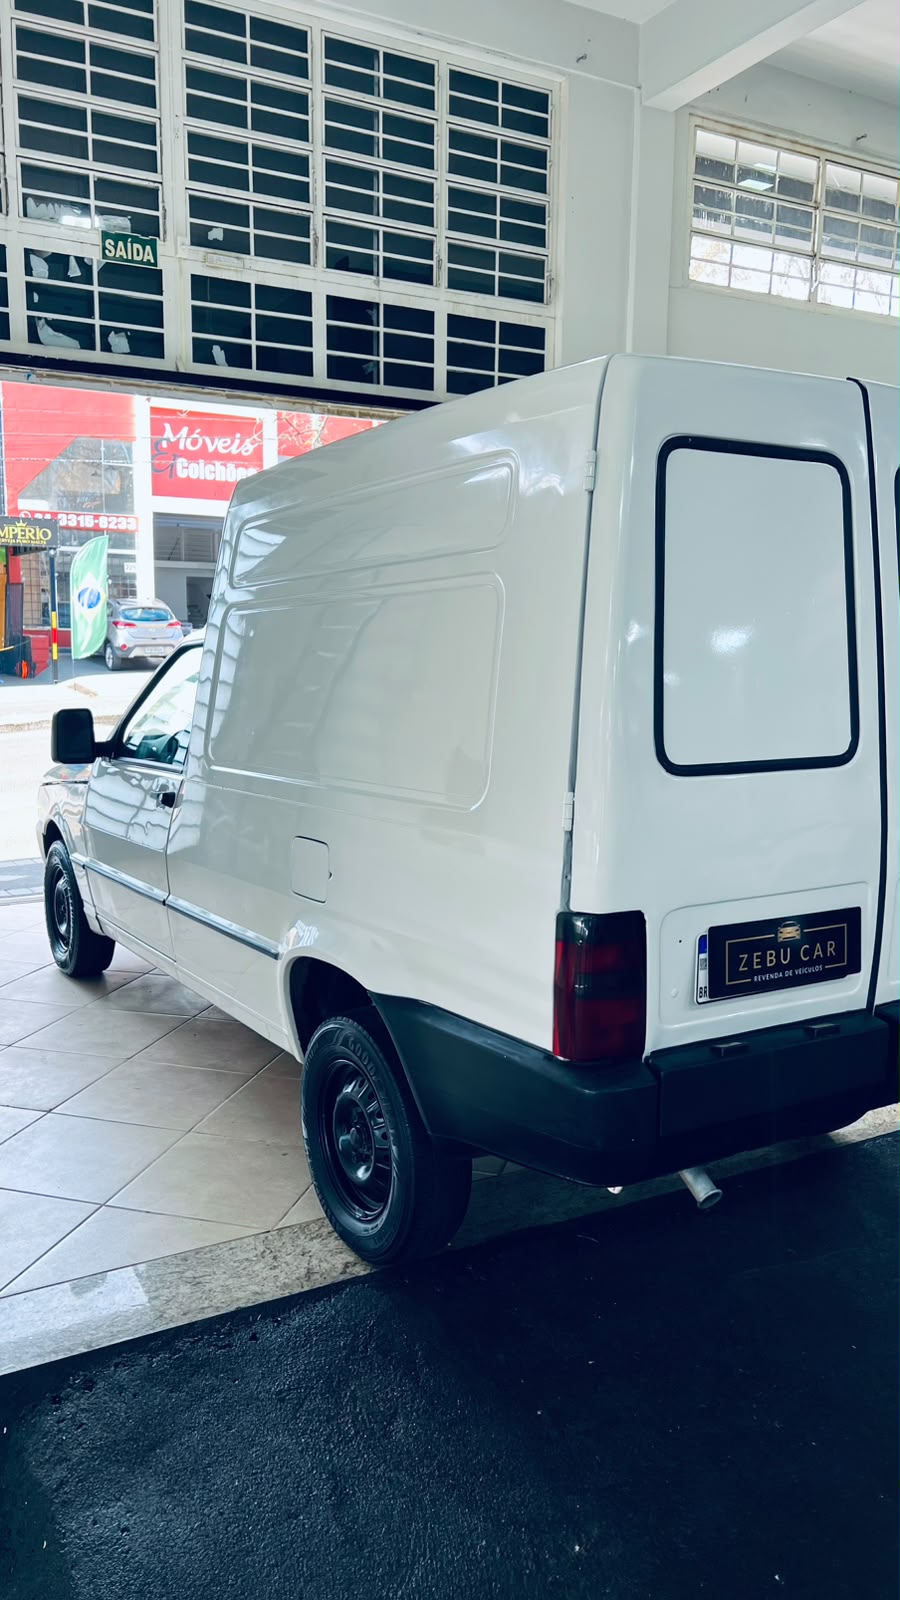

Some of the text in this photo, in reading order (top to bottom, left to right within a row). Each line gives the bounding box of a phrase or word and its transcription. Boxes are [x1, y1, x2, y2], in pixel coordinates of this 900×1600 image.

[104, 238, 155, 263] SAÍDA
[161, 422, 259, 456] Móveis
[738, 940, 837, 972] ZEBU CAR
[753, 964, 824, 983] REVENDA DE VEÍCULOS
[698, 985, 708, 999] BR
